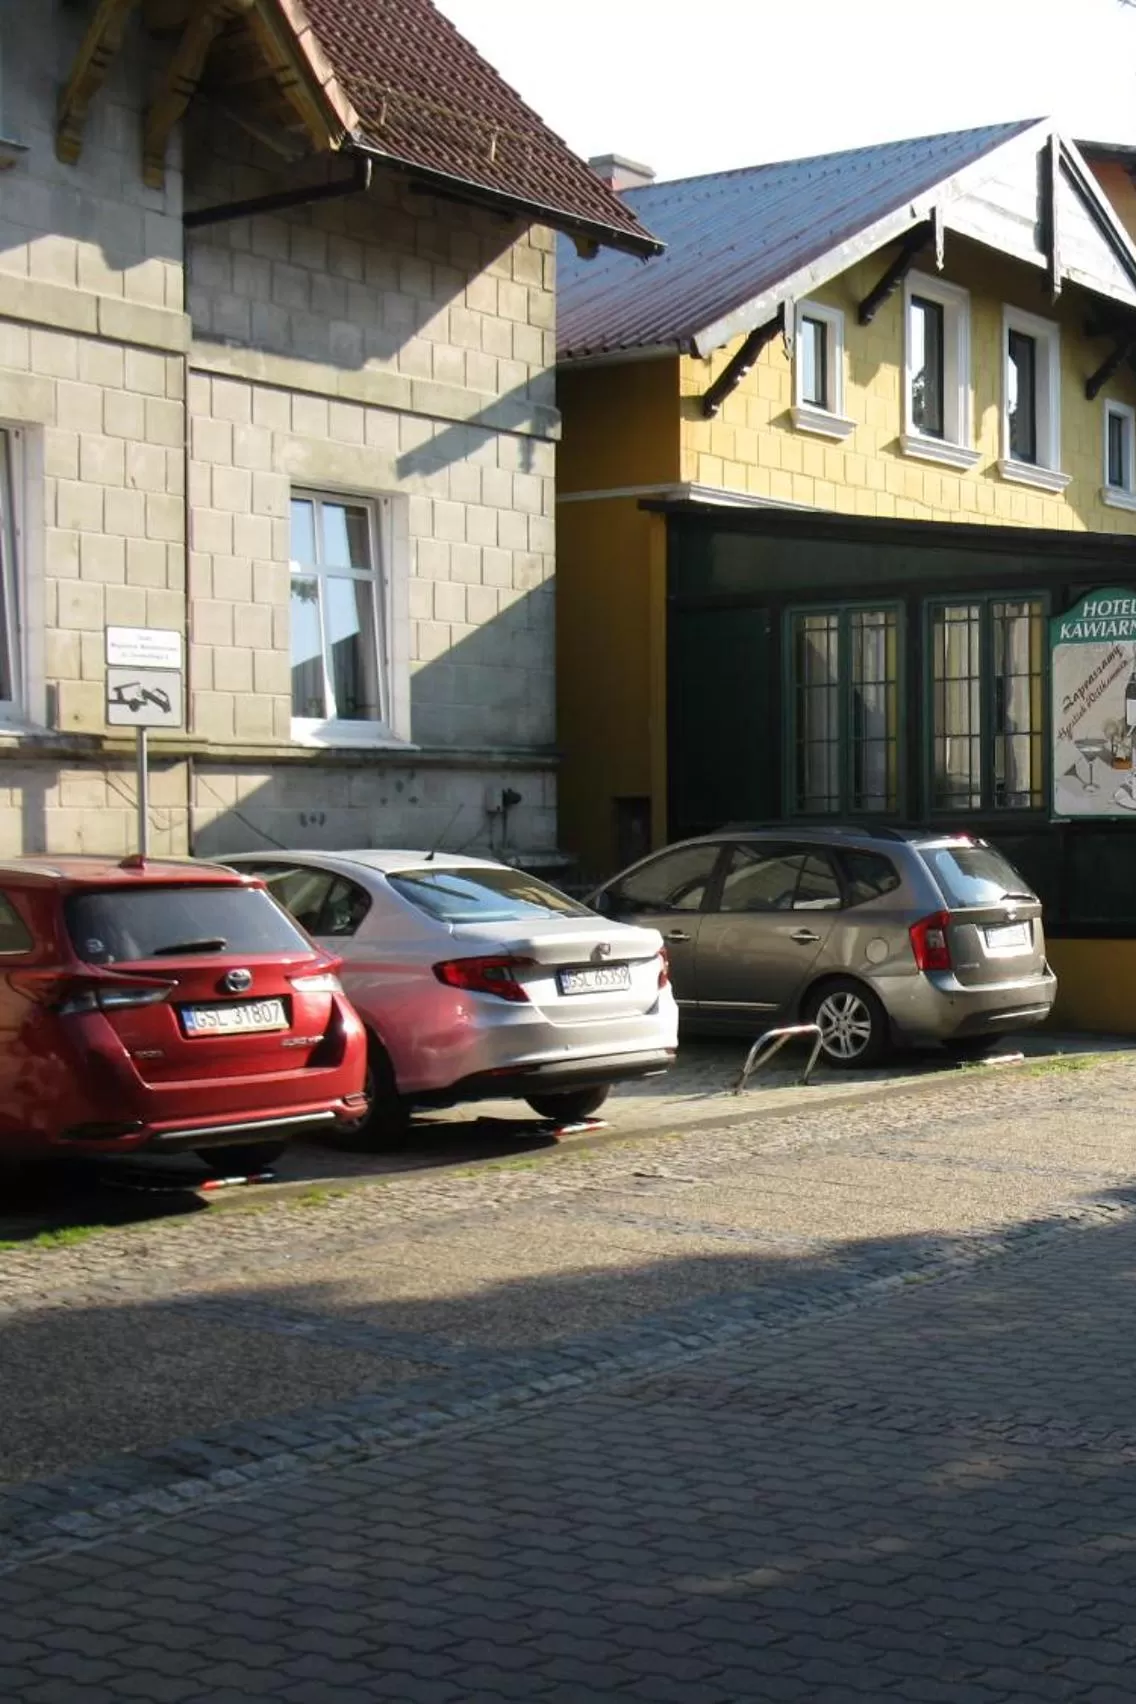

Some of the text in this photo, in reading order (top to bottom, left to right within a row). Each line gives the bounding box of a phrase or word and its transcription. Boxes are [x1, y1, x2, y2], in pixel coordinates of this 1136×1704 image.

[1063, 645, 1123, 714] Zapraszamy
[196, 1001, 280, 1027] GSL 31807
